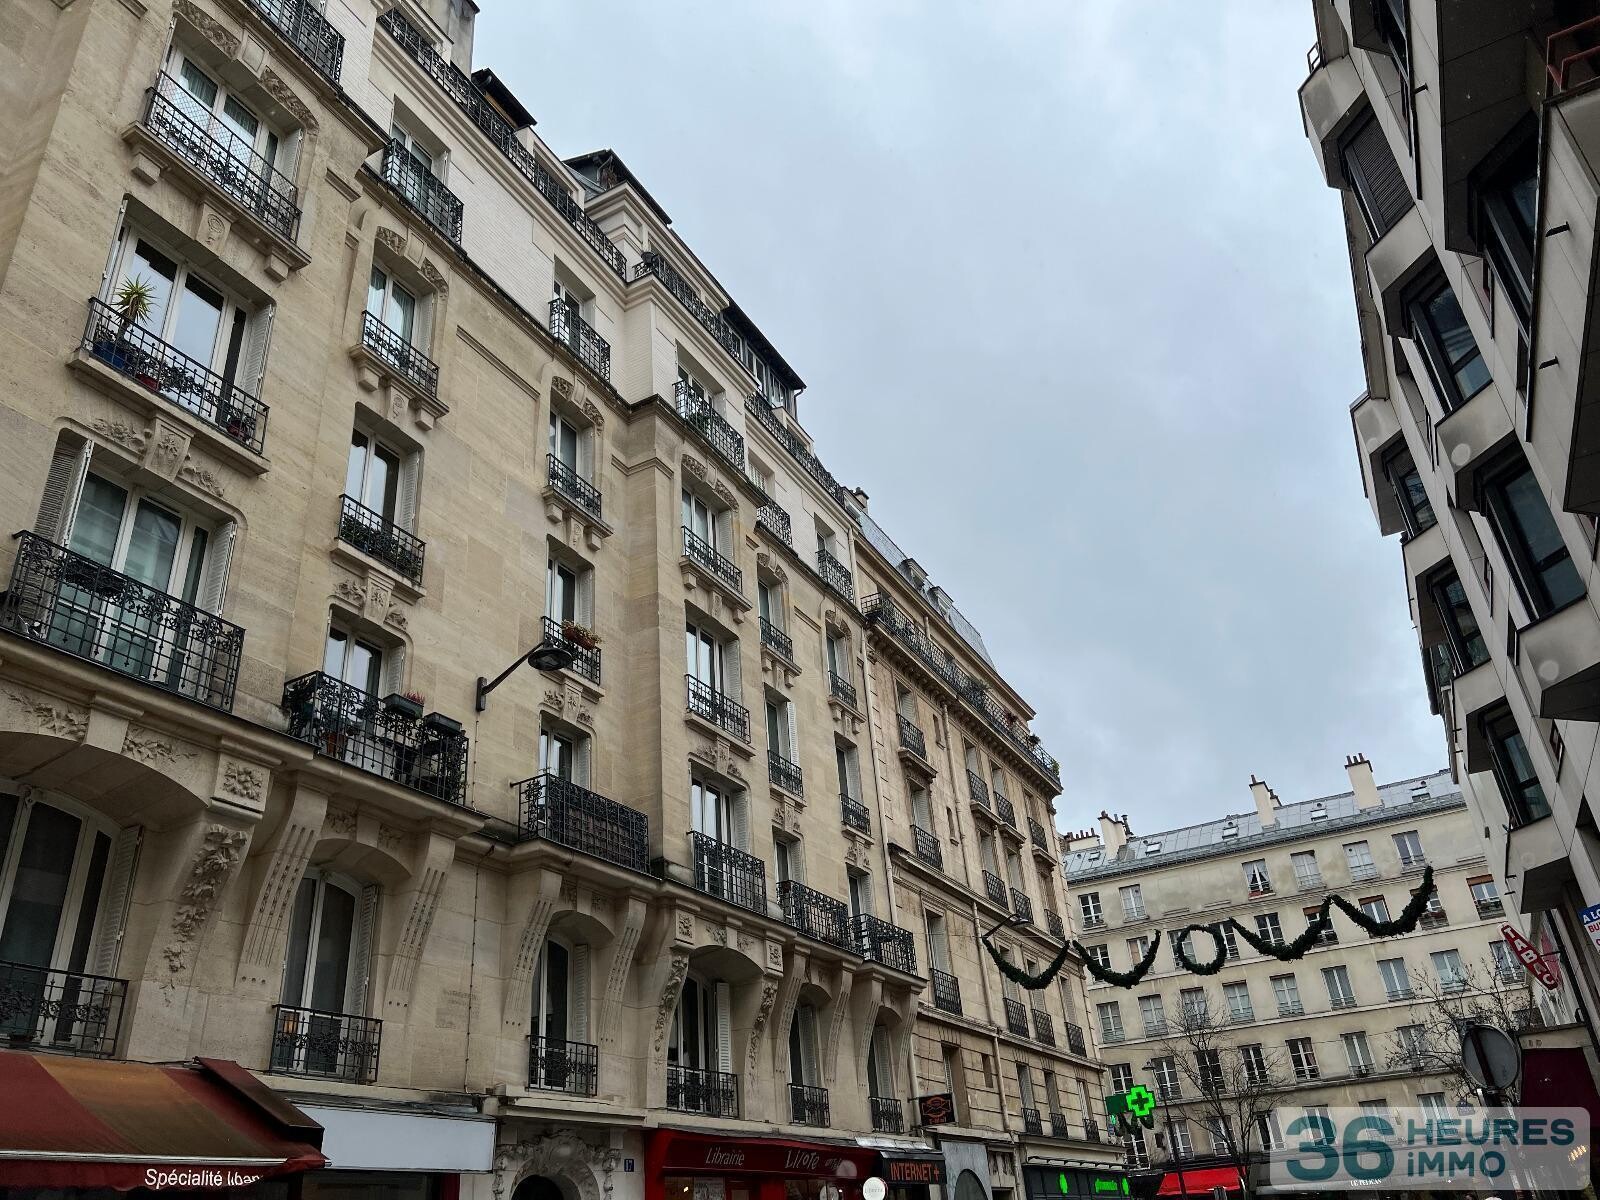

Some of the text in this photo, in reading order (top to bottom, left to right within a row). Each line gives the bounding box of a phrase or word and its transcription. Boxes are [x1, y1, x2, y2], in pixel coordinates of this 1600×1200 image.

[1503, 927, 1555, 985] TABAC
[705, 1147, 746, 1167] Librairie
[144, 1168, 223, 1190] Spécialité
[890, 1162, 931, 1181] INTERNET
